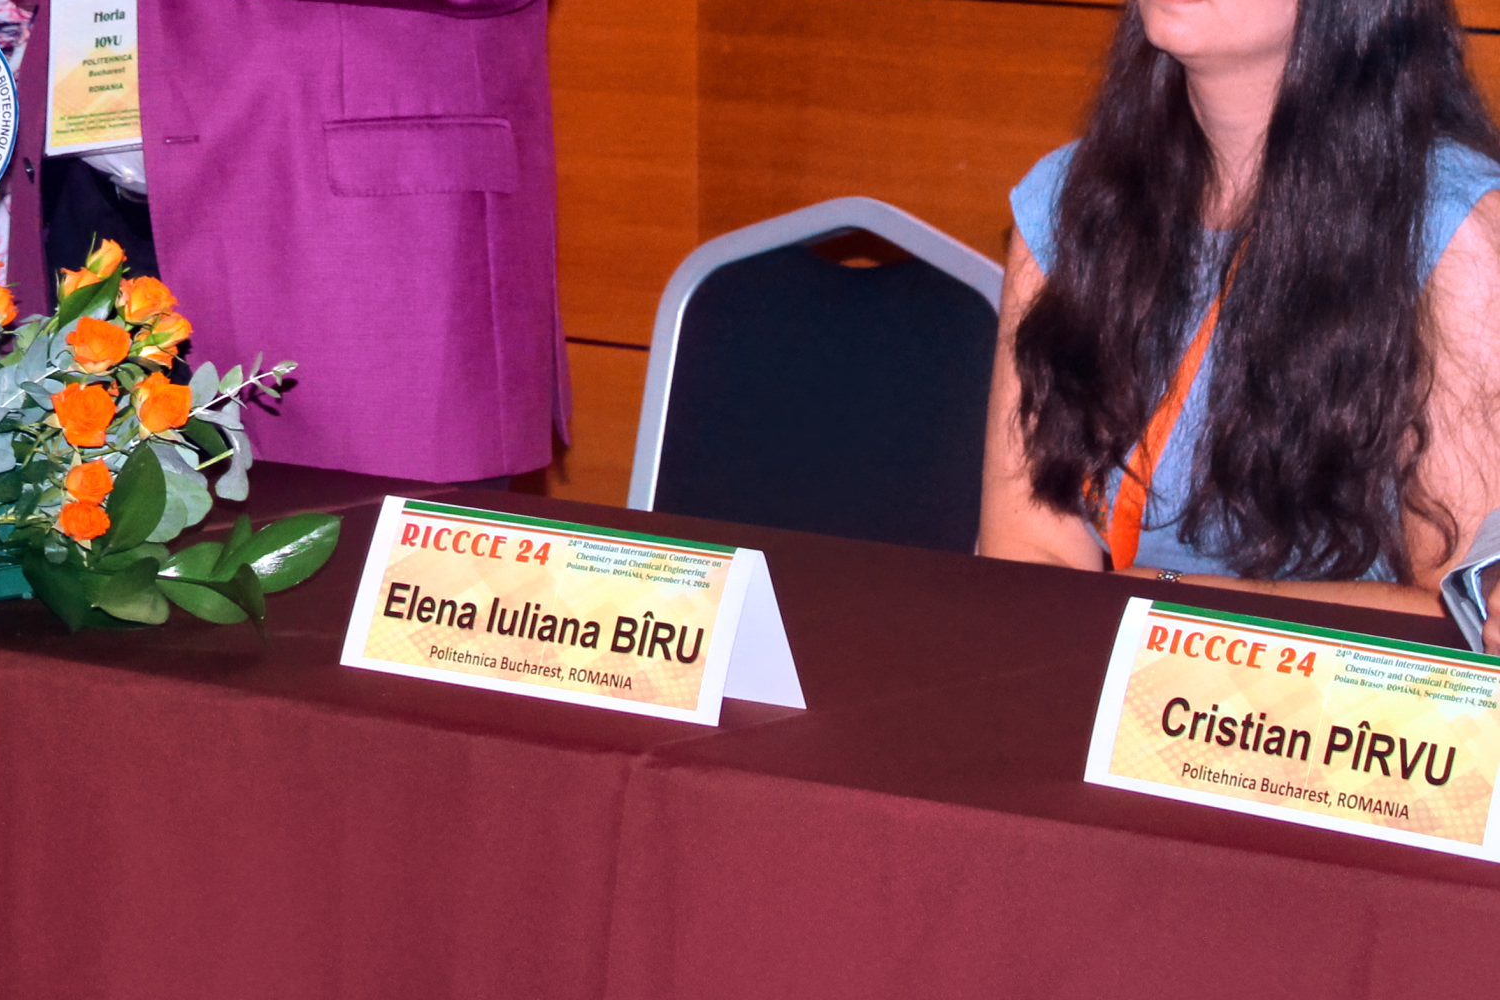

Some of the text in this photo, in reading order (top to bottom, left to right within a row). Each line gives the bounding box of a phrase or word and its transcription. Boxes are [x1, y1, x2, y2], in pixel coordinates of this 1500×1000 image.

[94, 9, 125, 23] Horia
[94, 35, 122, 49] IOVU
[82, 54, 133, 66] POLITEHNICA
[88, 67, 125, 78] Bucharest
[88, 82, 124, 93] ROMANIA
[401, 523, 552, 566] RICCCE 24
[583, 541, 619, 553] Romanian
[620, 547, 667, 561] International
[669, 553, 711, 567] Conference
[566, 562, 588, 572] Poiana
[645, 572, 680, 585] September
[576, 551, 707, 579] Chemistry and Chemical Engineering
[383, 582, 705, 664] Elena Iuliana BÎRU
[1146, 625, 1317, 678] RICCCE 24
[1335, 648, 1497, 684] 24th Romanian International Conference
[429, 645, 633, 690] Politehnica Bucharest, ROMANIA
[1345, 663, 1493, 698] Chemistry and Chemical Engineering
[1334, 674, 1359, 685] Poiana
[1423, 690, 1463, 705] September
[1161, 697, 1456, 786] Cristian PÎRVU
[1182, 762, 1409, 820] Politehnica Bucharest, ROMANIA
